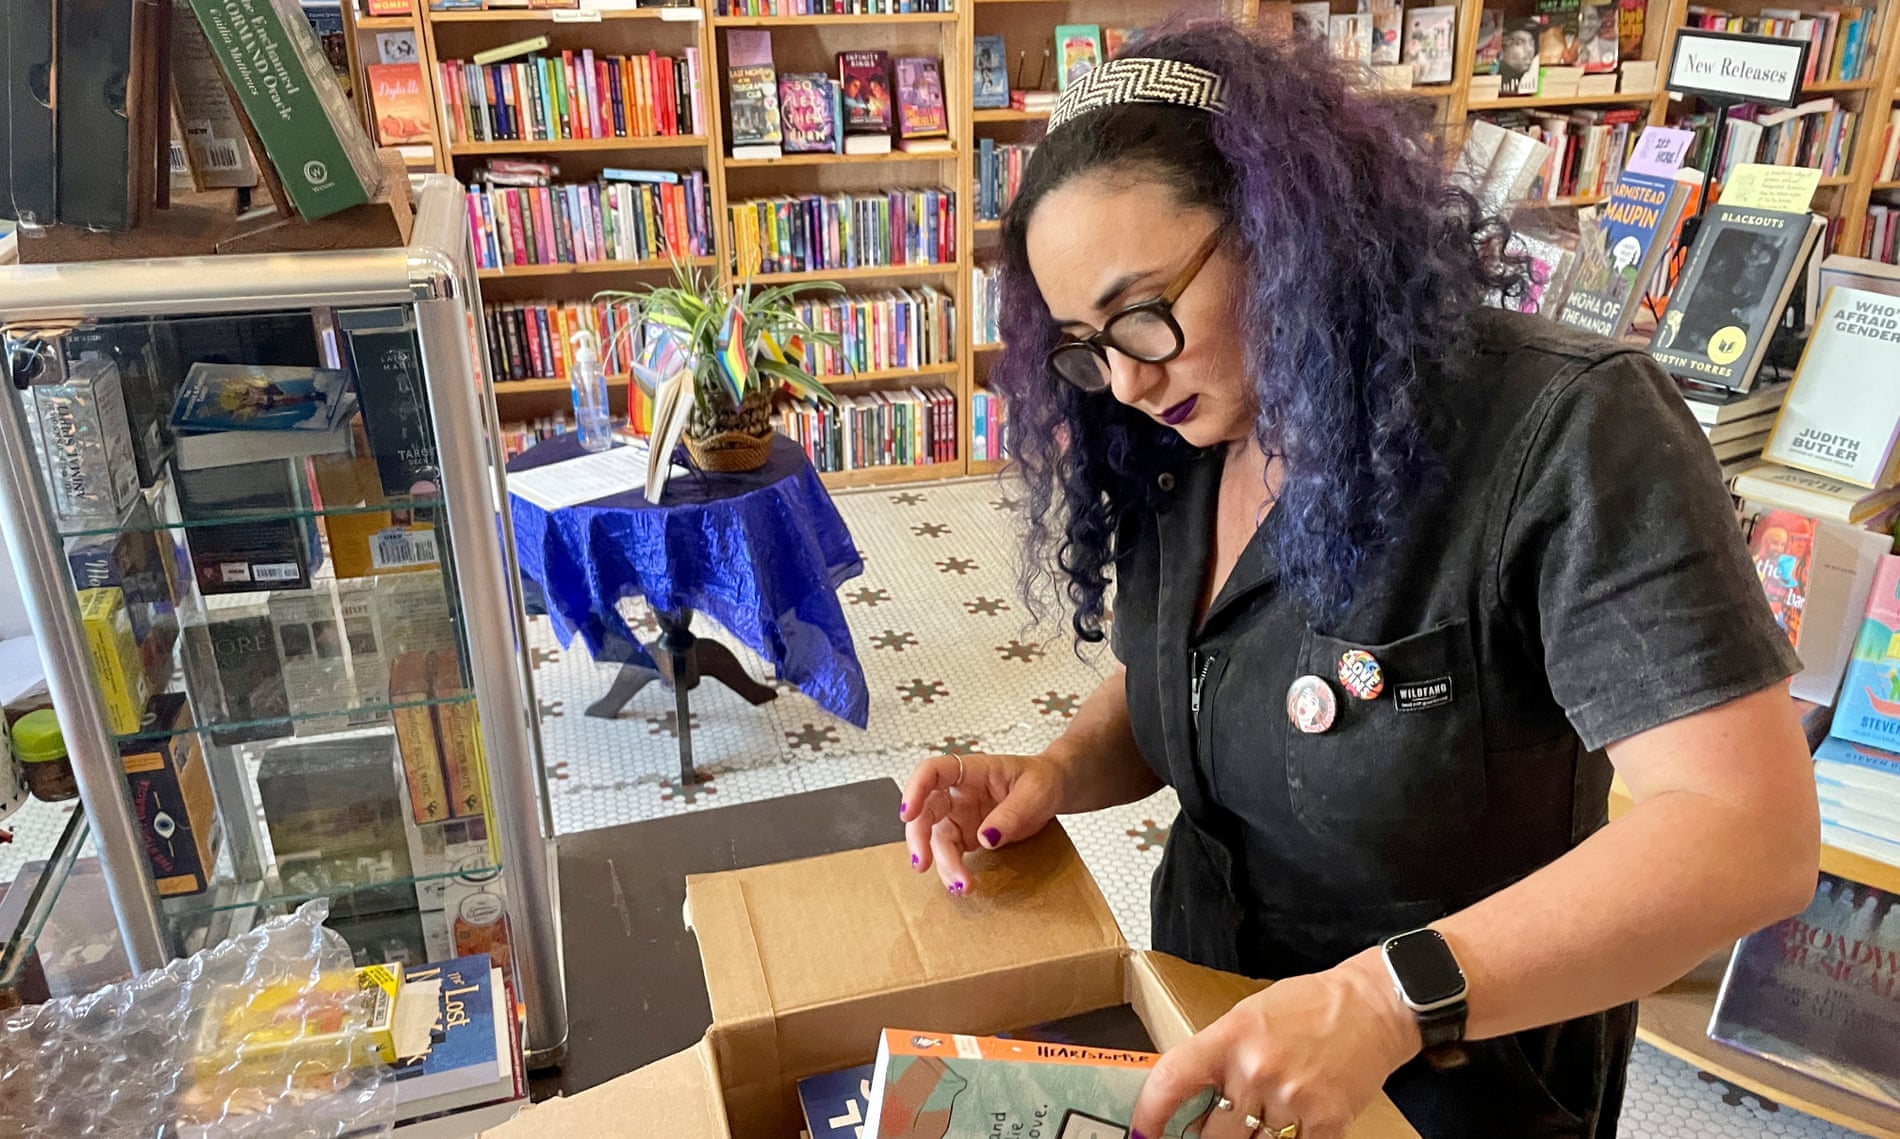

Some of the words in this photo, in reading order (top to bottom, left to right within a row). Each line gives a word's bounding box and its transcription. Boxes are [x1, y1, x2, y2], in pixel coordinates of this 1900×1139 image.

[222, 0, 269, 74] ORMAND
[263, 74, 292, 120] Oracle
[251, 15, 300, 95] Enchanted
[1684, 53, 1717, 76] New
[1720, 56, 1788, 85] Releases
[229, 46, 259, 96] Matthews
[1614, 184, 1666, 205] ARMISTEAD
[1603, 202, 1660, 230] MAUPIN
[1721, 212, 1786, 229] BLACKOUTS
[1567, 291, 1601, 314] MONA
[1602, 301, 1621, 319] OF
[1561, 308, 1579, 326] THE
[1579, 313, 1613, 337] MANOR
[1834, 310, 1898, 330] AFRAID
[1836, 321, 1900, 343] GENDER
[1690, 361, 1734, 378] TORRES
[1792, 437, 1858, 462] BUTLER
[1799, 428, 1861, 451] JUDITH
[1340, 663, 1370, 699] WINS
[1345, 649, 1380, 690] LOVE
[445, 983, 480, 1031] Lost
[1037, 1045, 1150, 1063] HEARTSTOPPER
